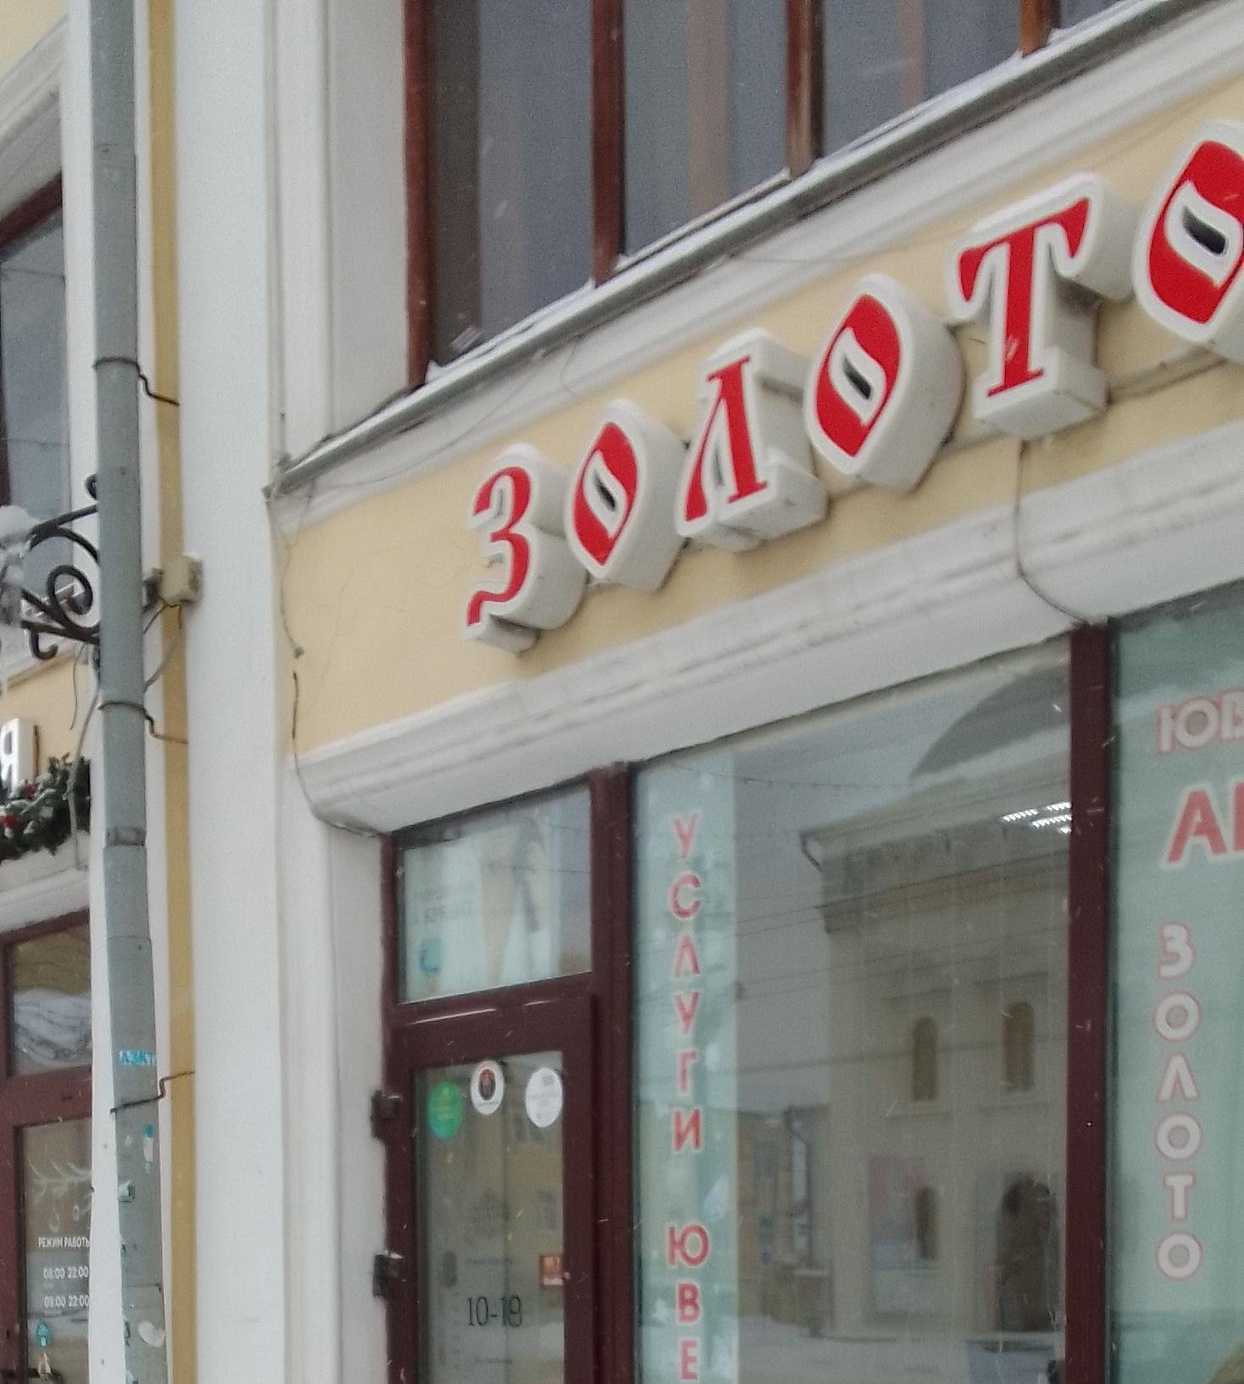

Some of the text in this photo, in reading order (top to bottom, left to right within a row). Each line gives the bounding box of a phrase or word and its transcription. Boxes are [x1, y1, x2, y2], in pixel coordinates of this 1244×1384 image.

[464, 132, 1244, 634] ЗОЛОТО
[670, 812, 702, 1152] УСЛУГИ
[1154, 921, 1202, 1281] ЗОЛОТО
